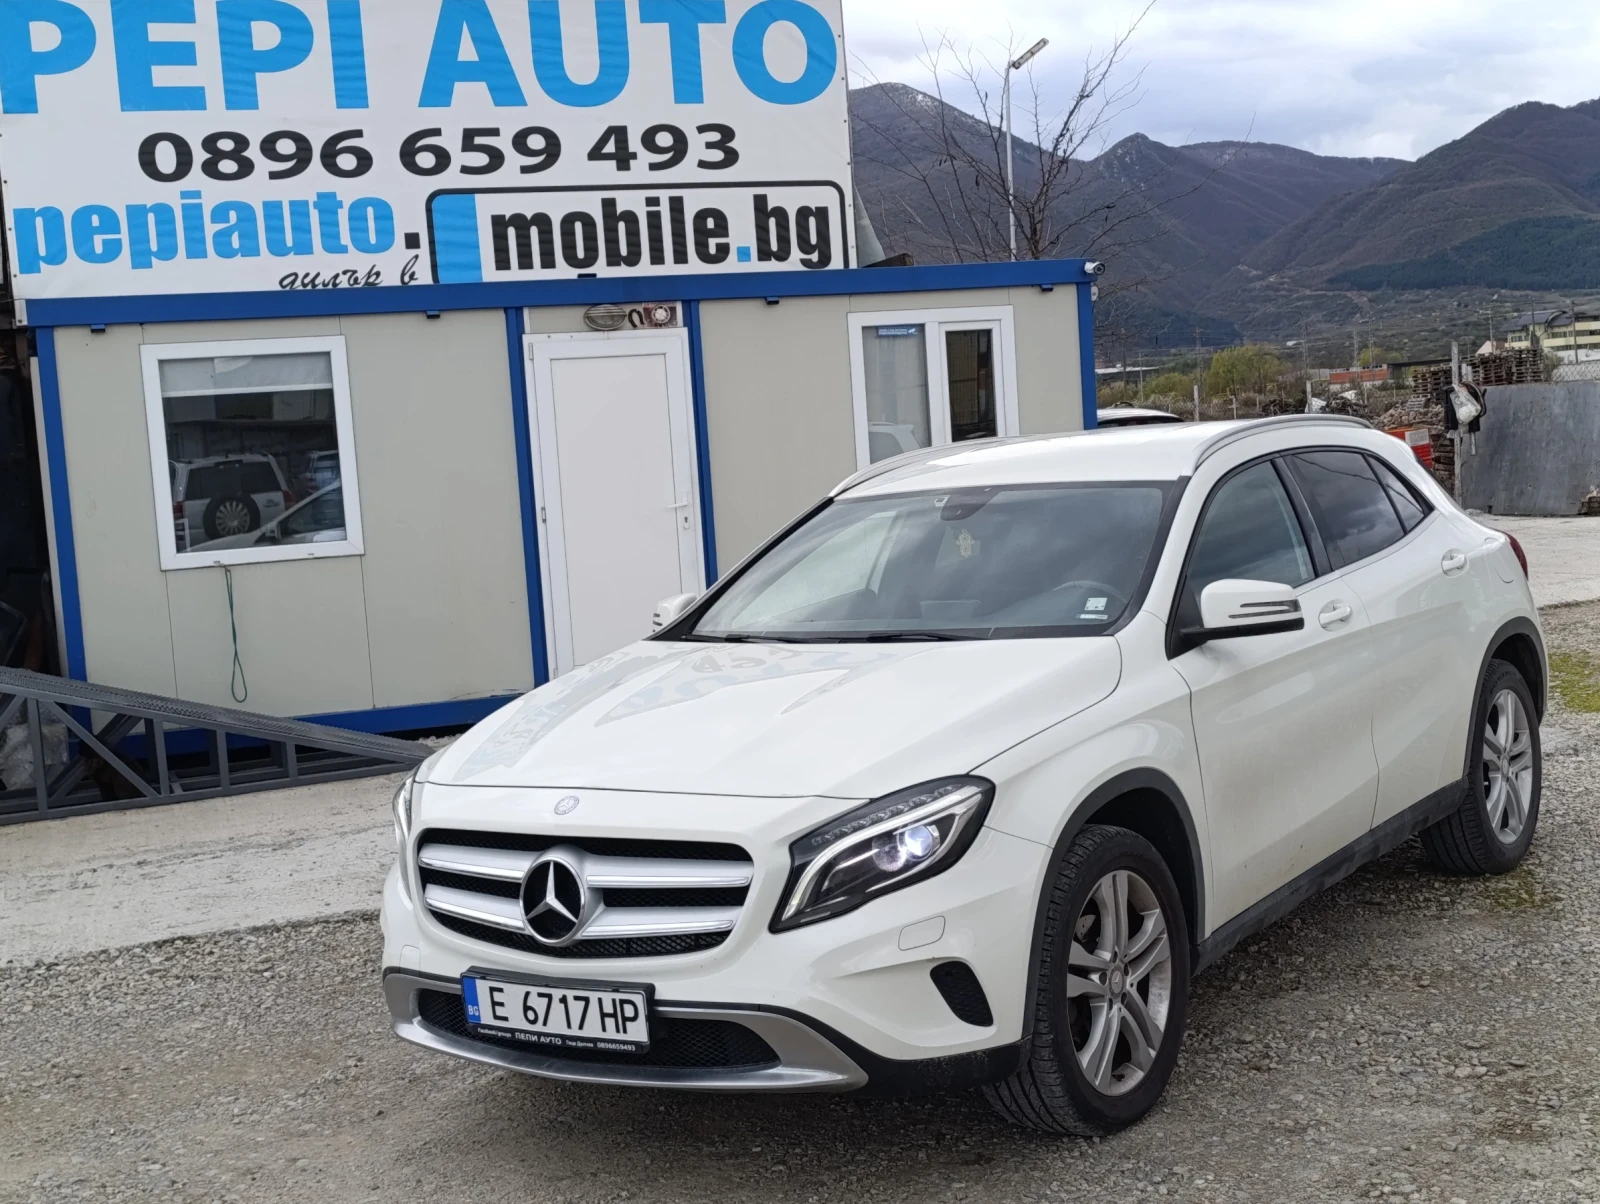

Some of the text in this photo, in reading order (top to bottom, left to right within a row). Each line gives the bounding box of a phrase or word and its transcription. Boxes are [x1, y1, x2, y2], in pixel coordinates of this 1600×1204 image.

[0, 0, 838, 114] PEPI AUTO
[138, 123, 740, 183] 0896 659 493
[490, 193, 833, 271] mobile.bg
[467, 1004, 480, 1016] BG
[489, 986, 639, 1034] E 6717 HP
